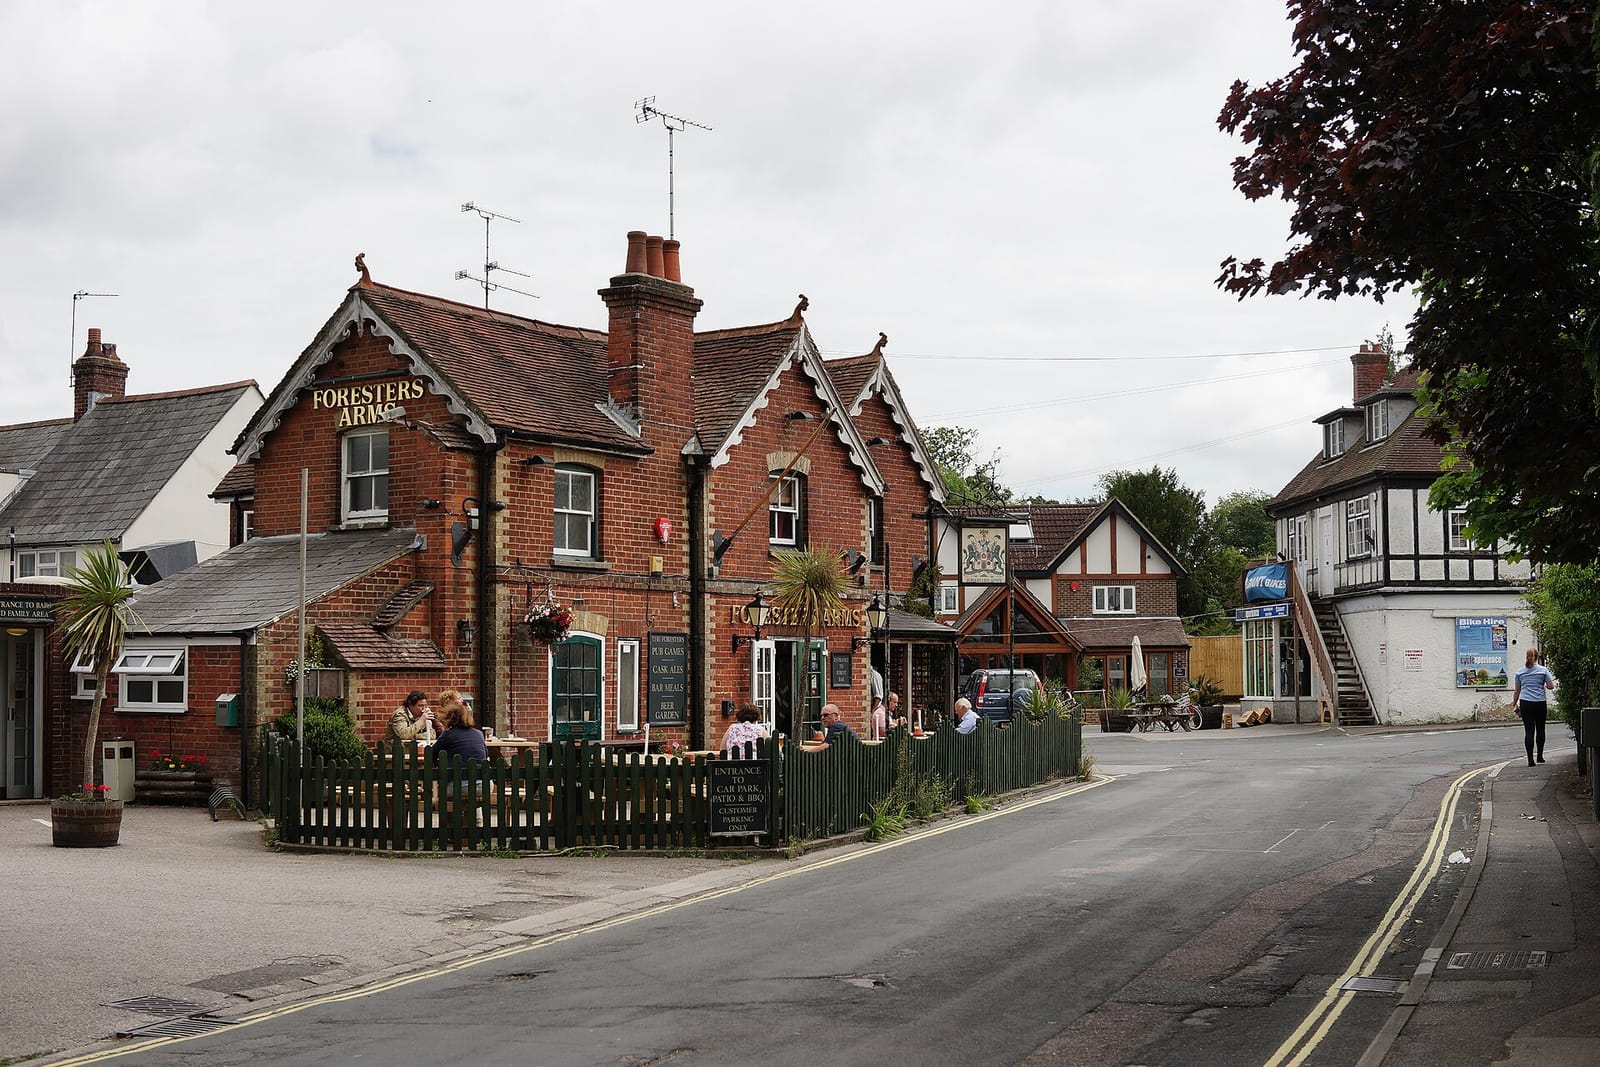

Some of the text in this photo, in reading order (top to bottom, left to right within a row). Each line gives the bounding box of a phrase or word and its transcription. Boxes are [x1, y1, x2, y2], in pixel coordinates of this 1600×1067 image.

[313, 379, 424, 409] FORESTERS
[1265, 579, 1286, 588] BIKES
[25, 601, 35, 609] TO
[823, 608, 860, 627] ARMS
[1459, 618, 1505, 626] Bike Hire
[651, 647, 685, 656] PUB GAMES
[652, 665, 684, 674] CASK ALES
[651, 683, 684, 692] BAR MEALS
[660, 701, 675, 710] BEER
[655, 711, 680, 720] GARDEN
[714, 767, 761, 775] ENTRANCE
[732, 776, 745, 784] TO
[716, 784, 762, 793] CAR PARK,
[712, 795, 736, 803] PATIO
[747, 793, 765, 803] BBQ
